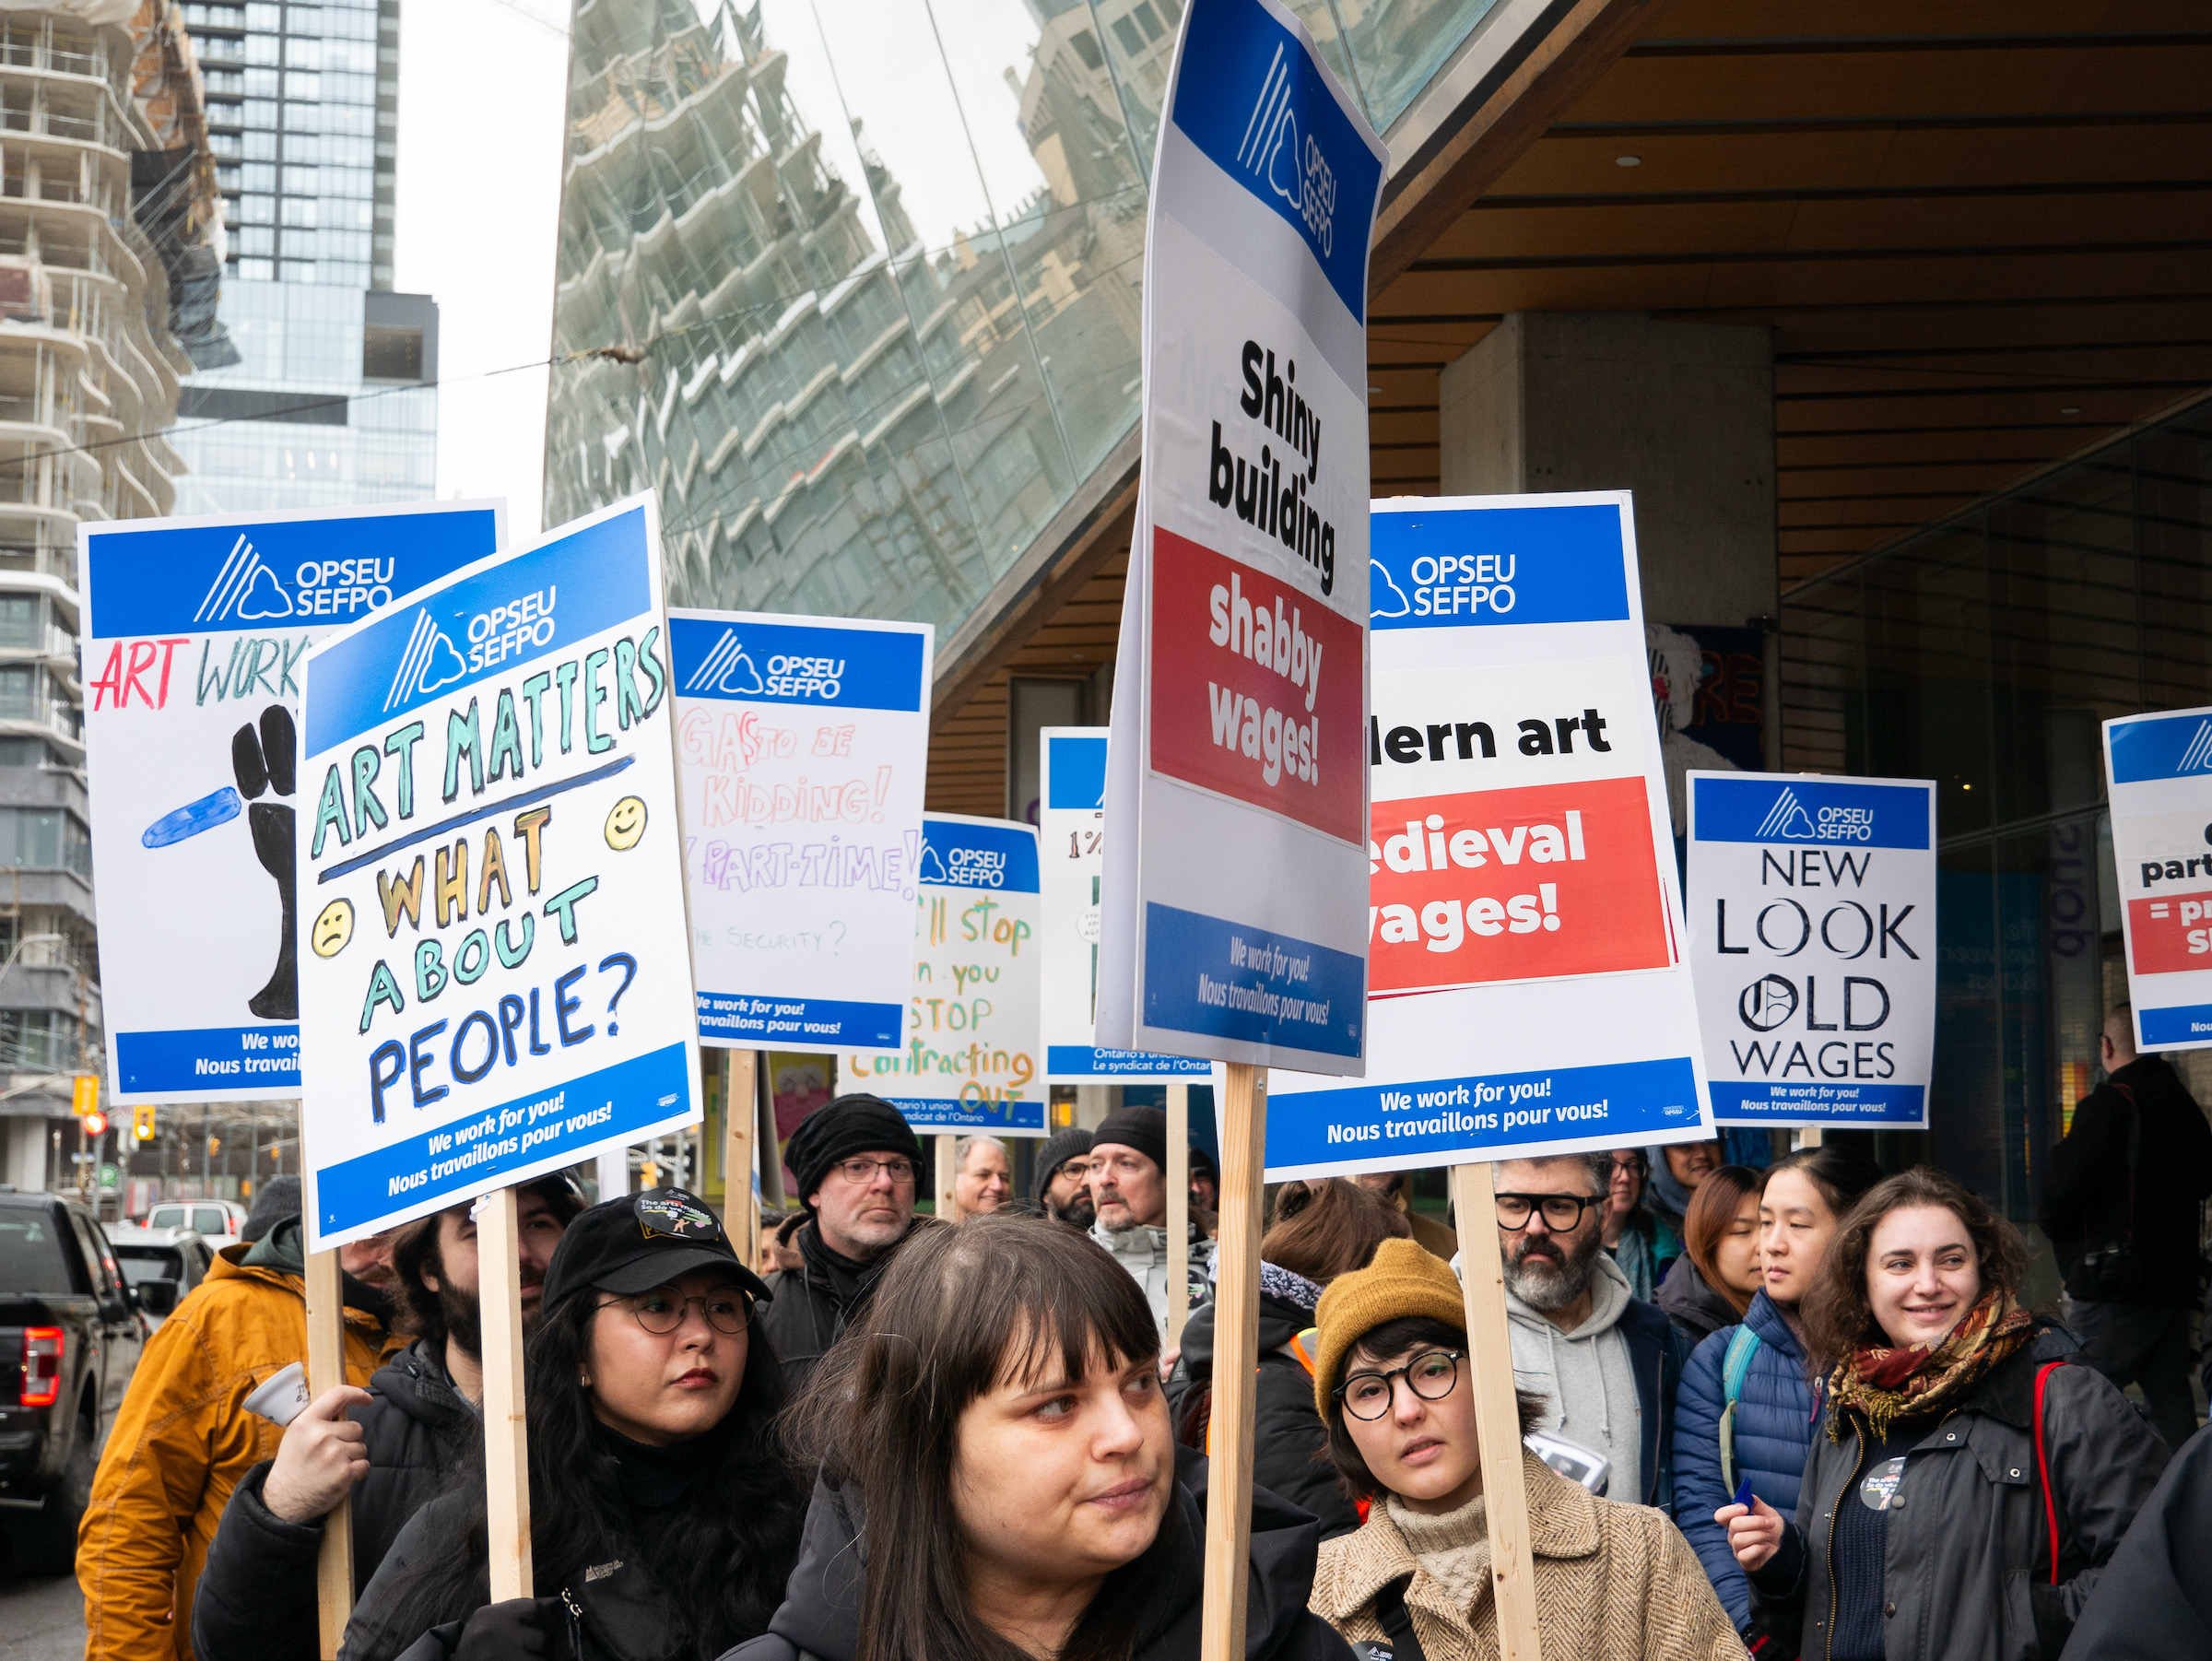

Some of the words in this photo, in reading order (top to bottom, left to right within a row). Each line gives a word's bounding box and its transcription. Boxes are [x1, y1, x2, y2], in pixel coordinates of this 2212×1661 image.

[1305, 134, 1336, 216] OPSEU
[1302, 179, 1333, 258] SEFPO
[1241, 340, 1321, 485] Shiny
[1209, 419, 1335, 596] building
[295, 557, 394, 587] OPSEU
[1411, 554, 1515, 585] OPSEU
[296, 584, 393, 617] SEFPO
[467, 585, 557, 642] OPSEU
[1413, 584, 1516, 616] SEFPO
[466, 615, 557, 672] SEFPO
[1209, 571, 1323, 713] shabby
[90, 638, 191, 712] ART
[196, 634, 312, 707] WORK
[767, 654, 845, 678] OPSEU
[764, 676, 841, 699] SEFPO
[311, 720, 425, 859] ART
[442, 626, 665, 805] MATTERS
[811, 724, 855, 757] BE
[1208, 681, 1319, 786] wages!
[1517, 709, 1612, 757] art
[1817, 822, 1872, 841] SEFPO
[1818, 807, 1874, 826] OPSEU
[377, 805, 552, 938] WHAT
[947, 866, 1005, 888] SEFPO
[948, 847, 1006, 870] OPSEU
[1761, 849, 1872, 888] NEW
[1717, 897, 1921, 960] LOOK
[359, 876, 599, 1036] ABOUT
[1230, 936, 1246, 967] We
[1248, 943, 1271, 973] work
[1270, 946, 1288, 982] for
[1287, 955, 1310, 985] you!
[952, 964, 999, 995] you
[713, 998, 748, 1012] work
[749, 999, 772, 1015] for
[773, 1003, 806, 1017] you!
[1198, 972, 1227, 1007] Nous
[1229, 981, 1279, 1016] travaillons
[1278, 995, 1304, 1025] pour
[1305, 999, 1330, 1026] vous!
[1738, 973, 1890, 1031] OLD
[241, 1033, 268, 1050] We
[273, 1035, 300, 1049] wo
[370, 952, 637, 1125] PEOPLE?
[698, 1014, 765, 1030] ravaillons
[766, 1019, 802, 1033] pour
[804, 1022, 841, 1034] vous!
[2191, 1021, 2212, 1032] Nou
[195, 1058, 241, 1075] Nous
[244, 1052, 301, 1073] travail
[1093, 1060, 1106, 1070] Le
[1109, 1060, 1153, 1073] syndicat
[1156, 1060, 1171, 1070] de
[1172, 1060, 1210, 1070] l'Ontar
[1730, 1040, 1895, 1078] WAGES
[1380, 1090, 1412, 1113] We
[1417, 1084, 1470, 1110] work
[1473, 1082, 1505, 1107] for
[1509, 1078, 1551, 1105] you!
[1741, 1099, 1769, 1111] Nous
[1771, 1100, 1830, 1112] travaillons
[1831, 1102, 1857, 1114] pour
[1858, 1102, 1886, 1112] vous!
[1770, 1086, 1787, 1097] We
[1789, 1086, 1818, 1097] work
[1818, 1086, 1835, 1100] for
[1836, 1088, 1859, 1101] you!
[429, 1134, 452, 1156] We
[454, 1114, 496, 1146] work
[498, 1107, 525, 1134] for
[528, 1091, 565, 1125] you!
[1326, 1119, 1381, 1144] Nous
[1384, 1109, 1499, 1138] travaillons
[1502, 1108, 1553, 1133] pour
[1555, 1099, 1608, 1123] vous!
[388, 1168, 428, 1196] Nous
[430, 1135, 518, 1179] travaillons
[521, 1122, 563, 1154] pour
[566, 1101, 612, 1133] vous!
